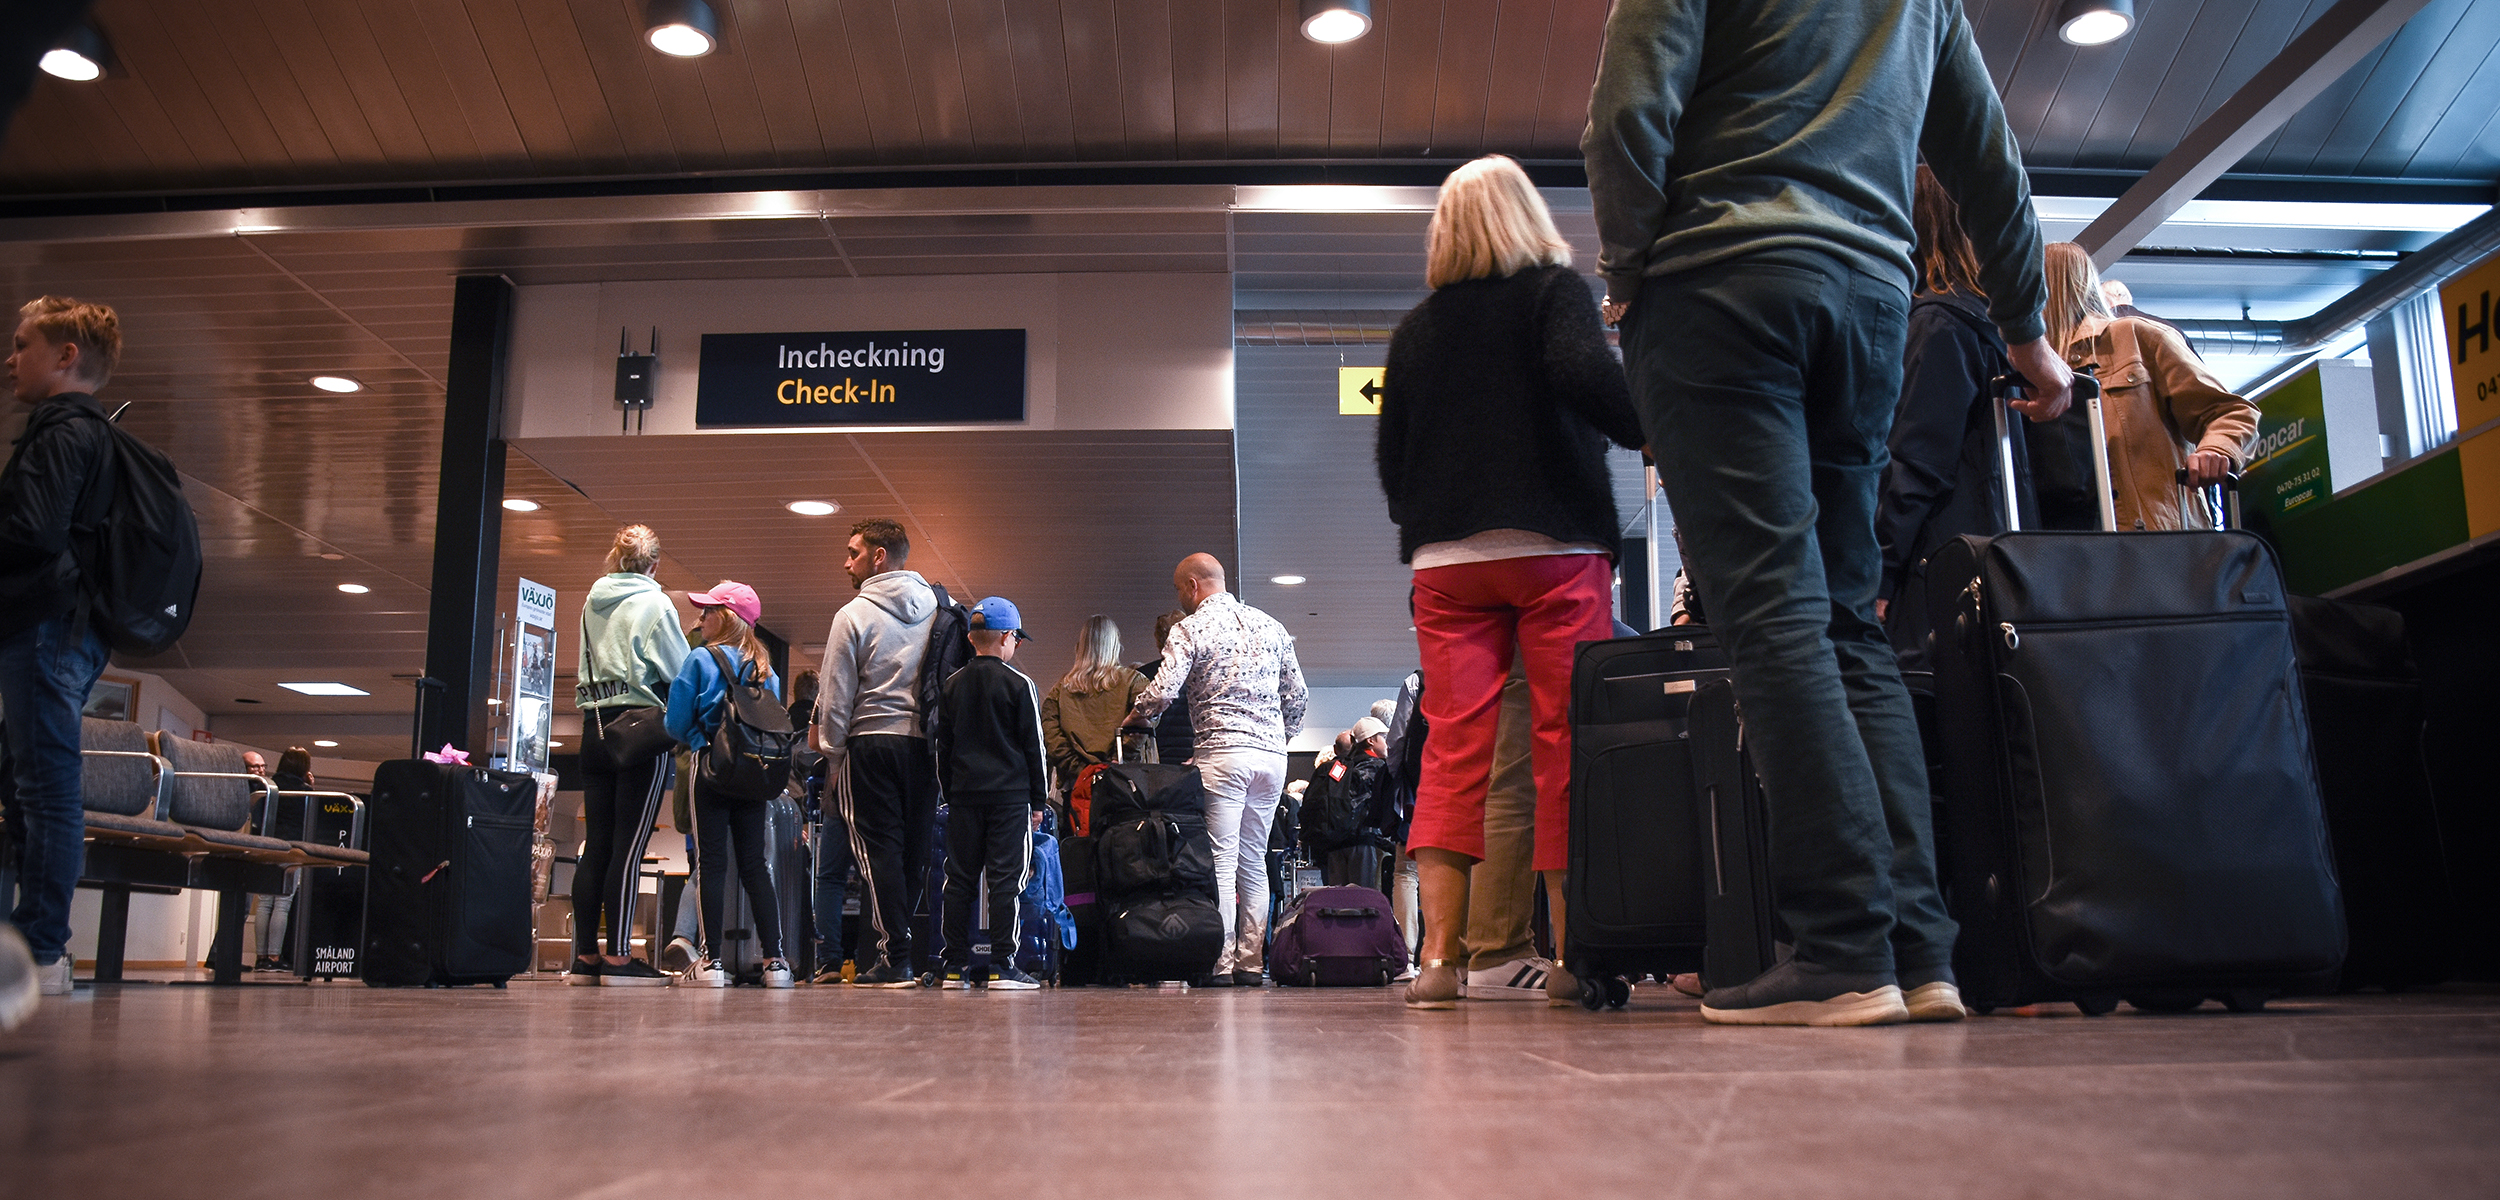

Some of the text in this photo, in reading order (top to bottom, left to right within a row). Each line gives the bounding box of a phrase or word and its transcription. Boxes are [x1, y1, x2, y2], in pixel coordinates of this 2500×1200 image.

[2458, 290, 2500, 365] H
[778, 341, 945, 373] Incheckning
[777, 378, 896, 405] Check-In
[2477, 374, 2500, 401] 04
[2257, 417, 2305, 460] opcar
[2276, 475, 2302, 495] 0470-75
[2284, 488, 2313, 508] Europcar
[521, 587, 554, 610] VÄXJÖ
[324, 803, 355, 813] VÄXJ
[315, 945, 355, 960] SMÅLAND
[314, 961, 355, 973] AIRPORT
